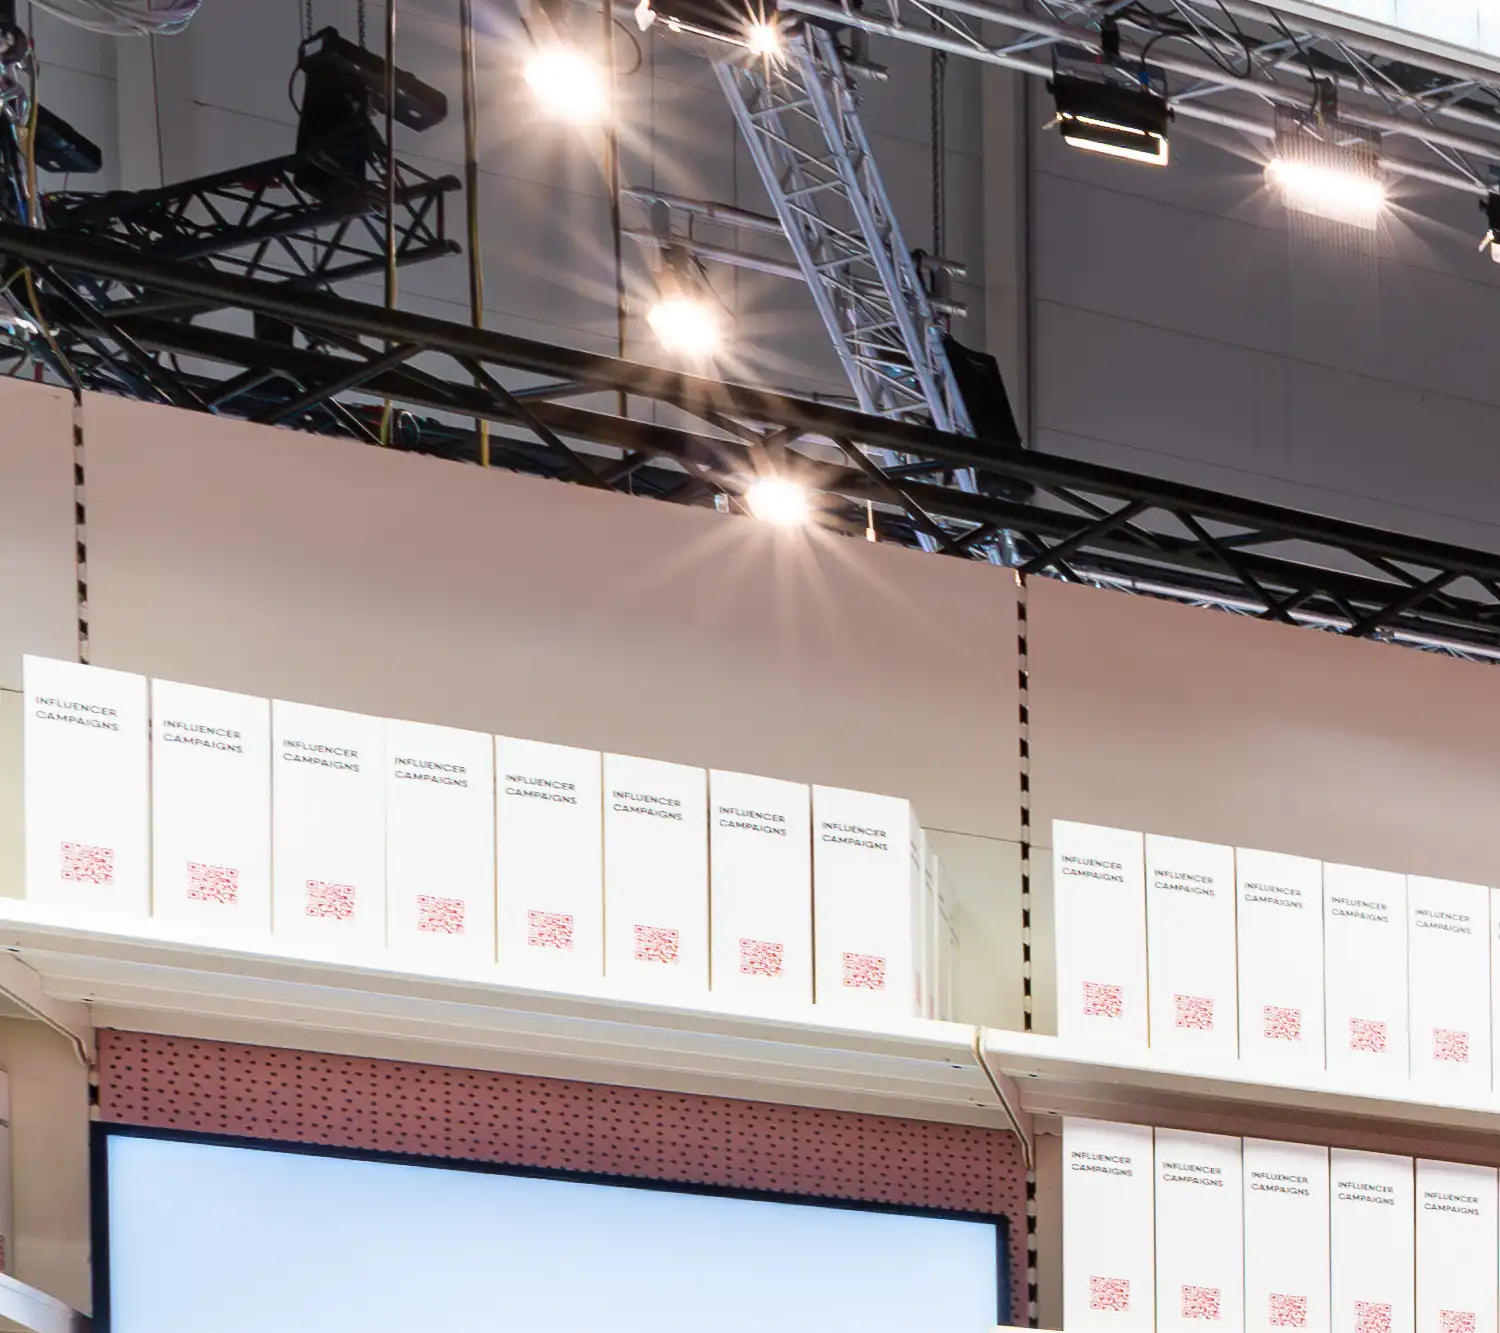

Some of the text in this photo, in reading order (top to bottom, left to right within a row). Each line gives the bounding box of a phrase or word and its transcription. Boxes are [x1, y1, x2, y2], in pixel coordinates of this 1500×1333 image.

[36, 696, 117, 717] INFLUENCER
[36, 710, 119, 732] CAMPAIGNS
[164, 720, 241, 739] INFLUENCER
[163, 734, 243, 754] CAMPAIGNS
[283, 740, 358, 758] INFLUENCER
[282, 752, 360, 772] CAMPAIGNS
[506, 774, 576, 791] INFLUENCER
[506, 787, 577, 804] CAMPAIGNS
[612, 790, 681, 807] INFLUENCER
[613, 803, 683, 821] CAMPAIGNS
[822, 822, 887, 838] INFLUENCER
[822, 834, 888, 851] CAMPAIGNS
[1062, 856, 1122, 870] INFLUENCER
[1062, 867, 1124, 883] CAMPAIGNS
[1162, 1162, 1222, 1174] INFLUENCER
[1162, 1174, 1224, 1187] CAMPAIGNS
